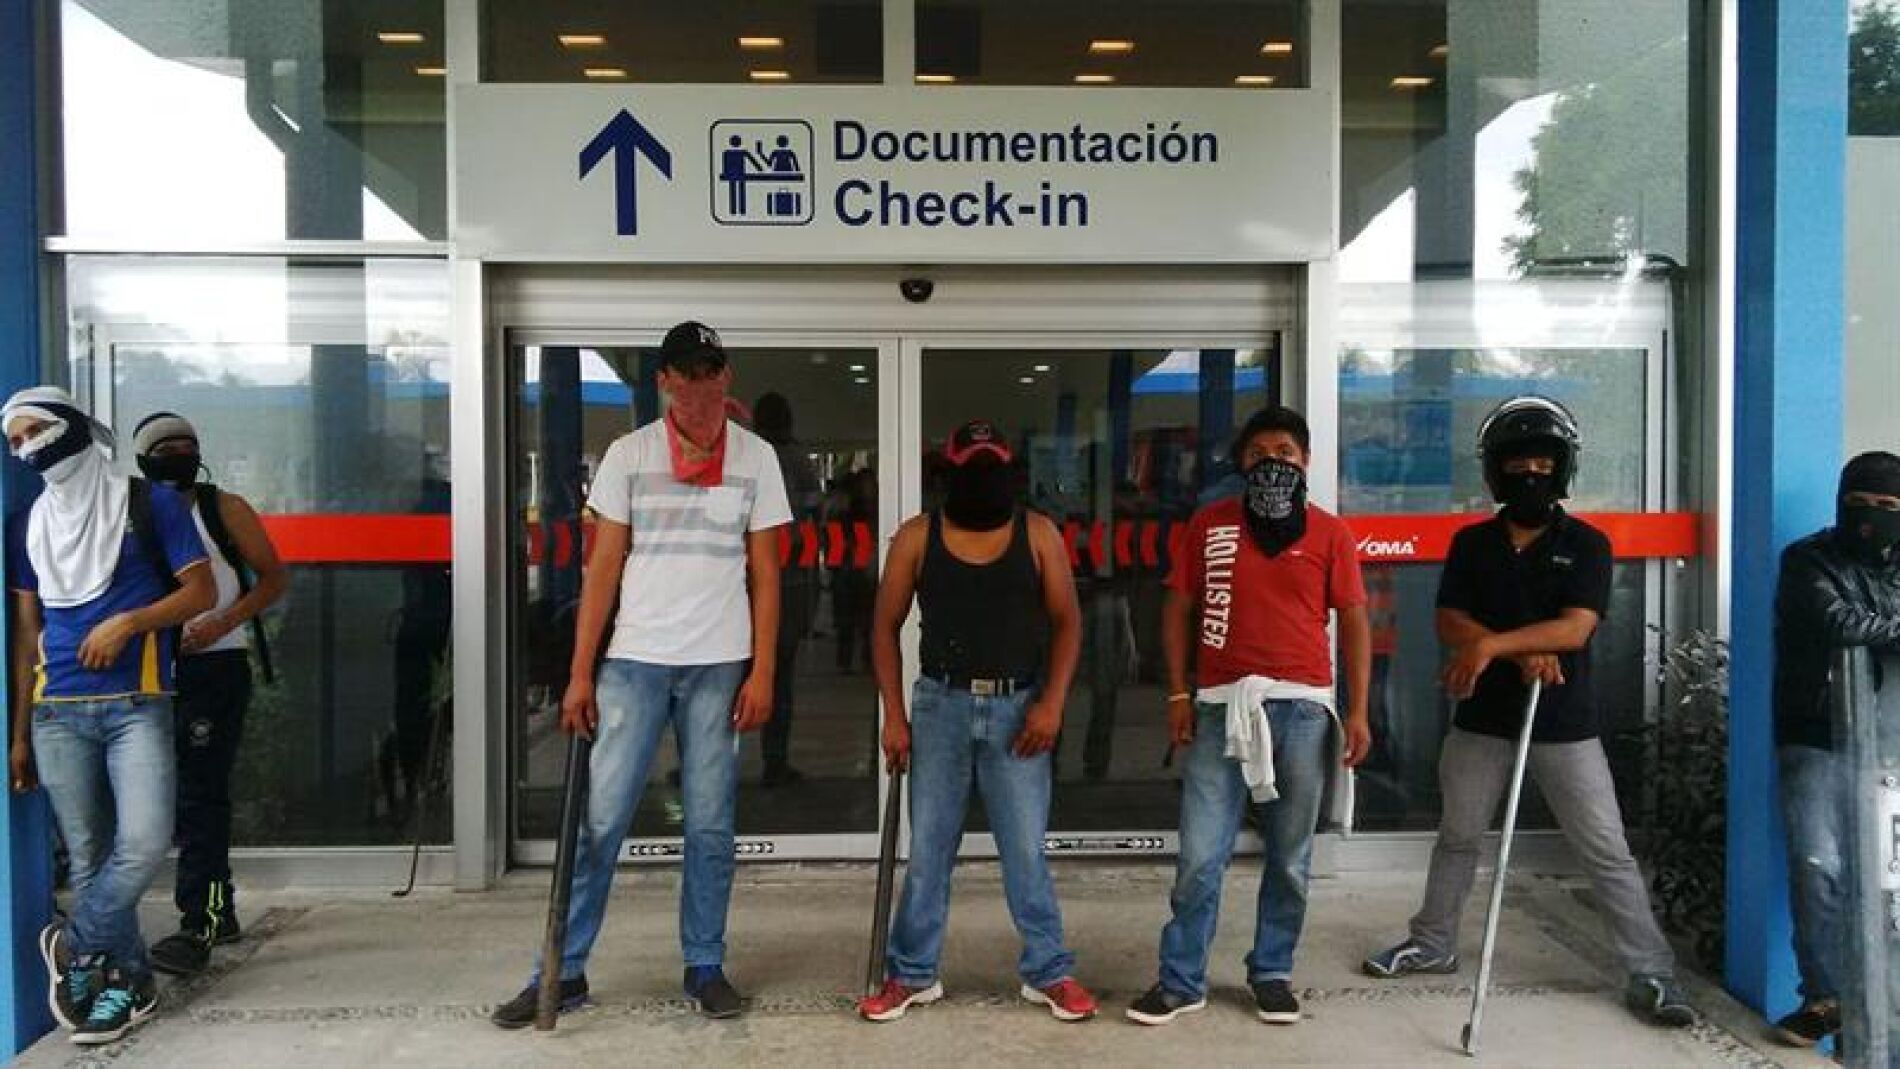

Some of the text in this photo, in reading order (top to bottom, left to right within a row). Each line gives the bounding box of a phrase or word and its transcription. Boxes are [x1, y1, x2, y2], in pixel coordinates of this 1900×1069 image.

[834, 120, 1218, 162] Documentación
[834, 181, 1089, 227] Check-in
[1366, 539, 1415, 556] OMA
[1202, 525, 1240, 649] HOLLISTER
